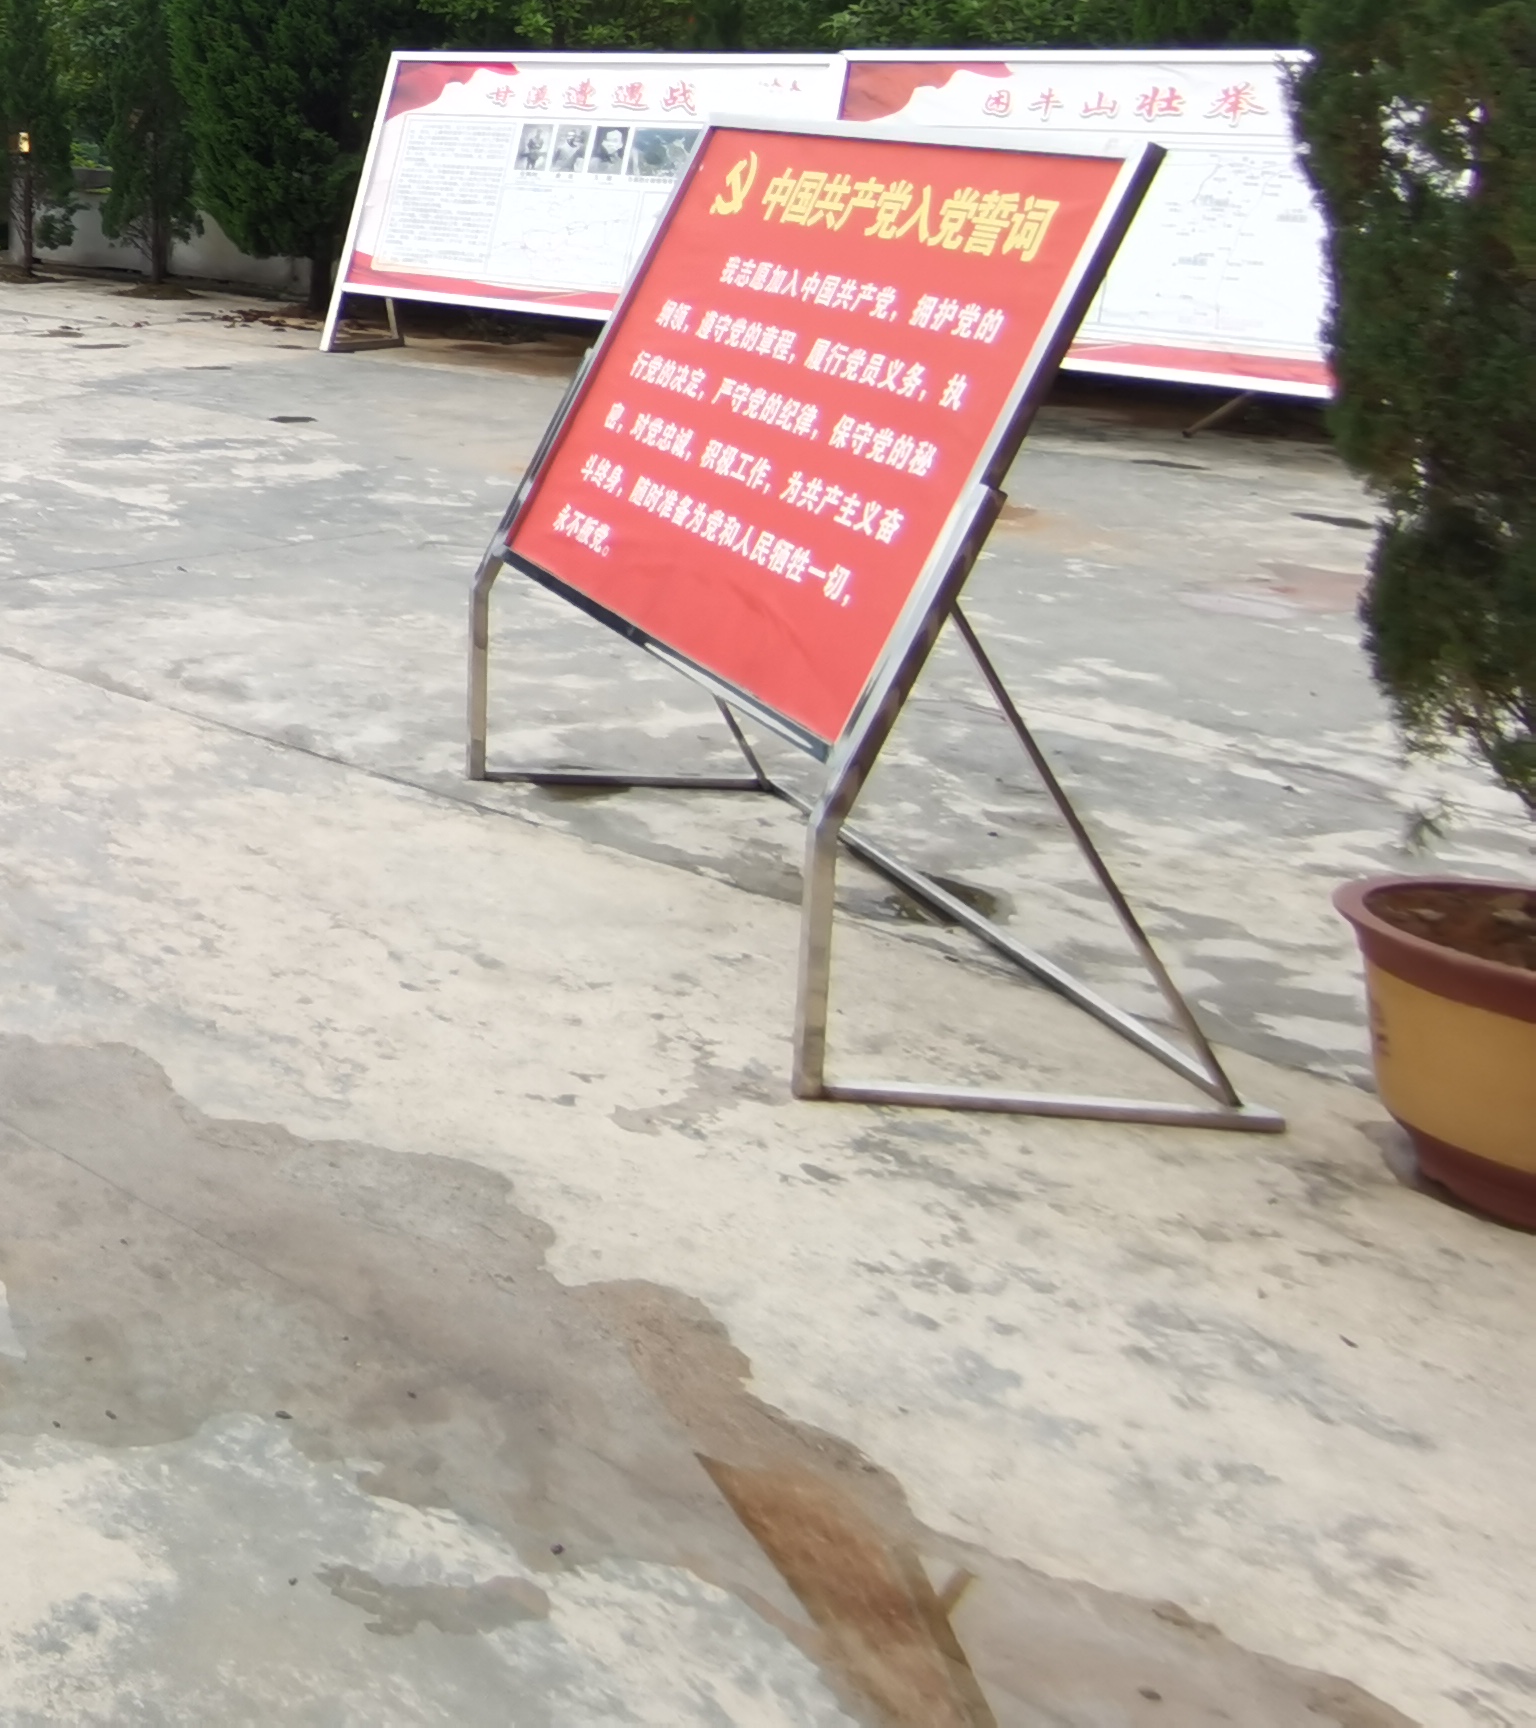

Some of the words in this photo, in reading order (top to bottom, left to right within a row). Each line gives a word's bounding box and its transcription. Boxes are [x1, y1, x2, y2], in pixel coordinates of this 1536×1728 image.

[485, 78, 698, 116] 甘溪遭遇战
[982, 81, 1269, 127] 困牛山壮举
[761, 167, 1060, 262] 中国共产党入党誓词
[719, 255, 1005, 345] 我志愿加入中国共产党，拥护党的
[655, 298, 970, 412] 纲领，遵守党的章程，履行党员义务，执
[629, 350, 938, 478] 行党的决定，严守党的纪律，保守党的秘
[603, 401, 905, 545] 密，对党忠诚，积极工作，为共产主义奋
[580, 453, 852, 607] 斗终身，随时准备为党和人民牺牲一切，
